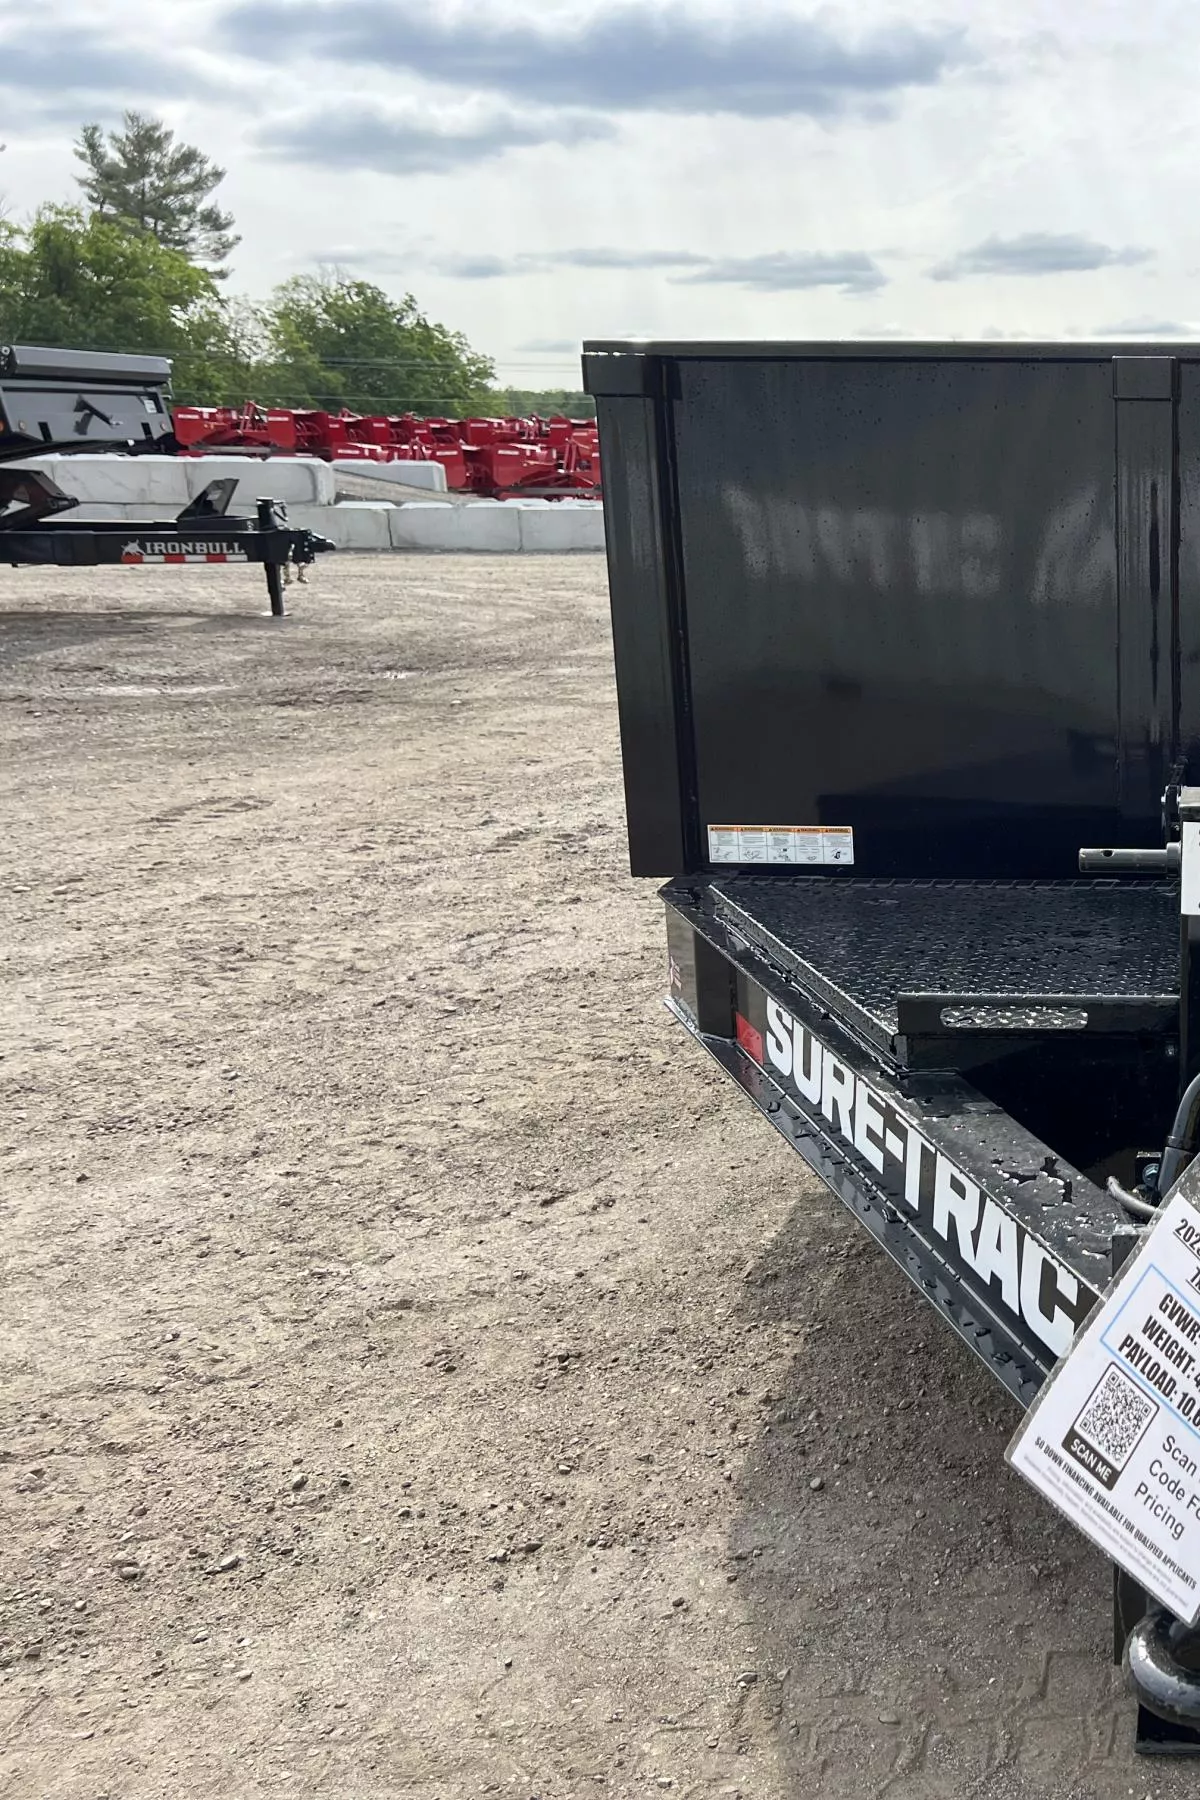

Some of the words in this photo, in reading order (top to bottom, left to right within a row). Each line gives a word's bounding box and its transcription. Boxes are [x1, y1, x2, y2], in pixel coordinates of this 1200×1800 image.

[145, 542, 245, 554] IRONBULL
[766, 996, 1078, 1357] SURE-TRAC
[1118, 1333, 1178, 1402] PAYLOAD:
[1141, 1315, 1196, 1379] WEIGHT:
[1070, 1438, 1098, 1468] SCAN
[1095, 1461, 1112, 1482] ME
[1149, 1459, 1185, 1501] Code
[1162, 1435, 1199, 1477] Scan
[1043, 1444, 1065, 1467] DOWN
[1062, 1462, 1095, 1496] FINANCING
[1093, 1491, 1124, 1523] AVAILABLE
[1121, 1518, 1135, 1535] FOR
[1133, 1528, 1164, 1559] QUALIFIED
[1162, 1555, 1197, 1590] APPLICANTS
[1134, 1482, 1185, 1541] Pricing
